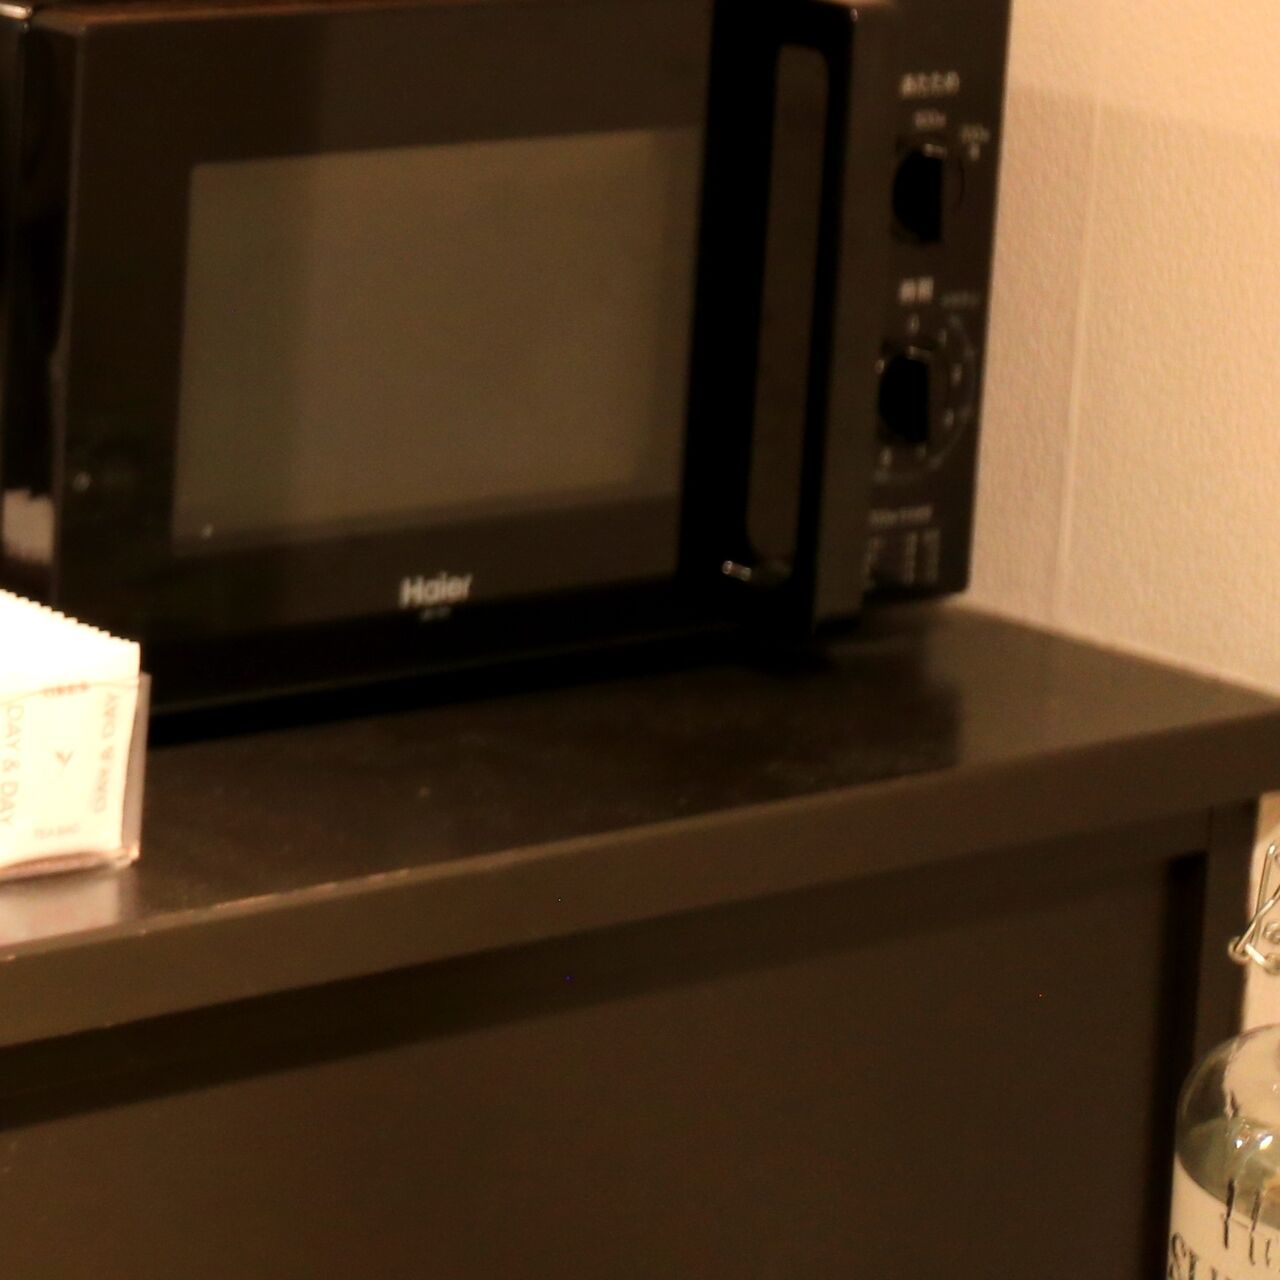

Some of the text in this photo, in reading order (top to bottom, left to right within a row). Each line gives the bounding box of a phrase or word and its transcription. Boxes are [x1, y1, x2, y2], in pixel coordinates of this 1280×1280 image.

[0, 704, 24, 826] DAY & DAY
